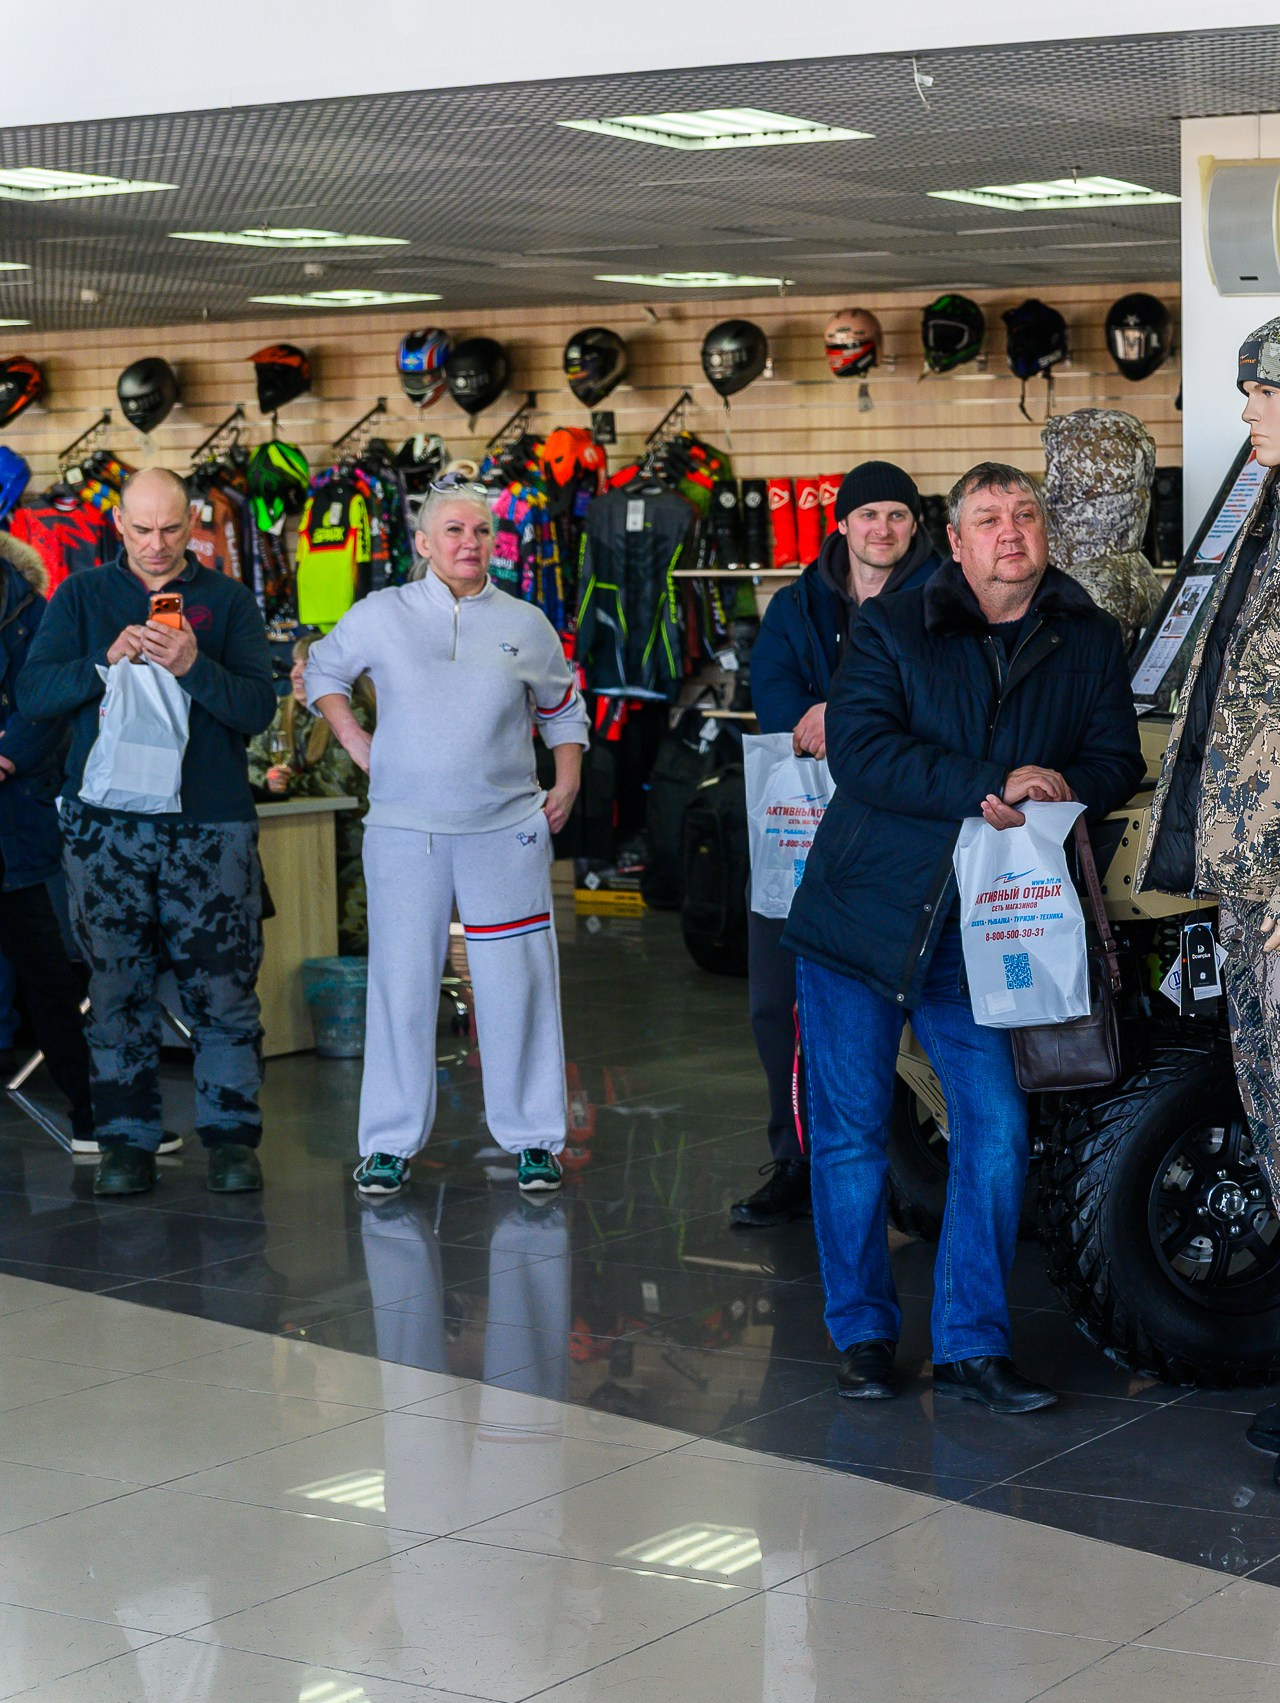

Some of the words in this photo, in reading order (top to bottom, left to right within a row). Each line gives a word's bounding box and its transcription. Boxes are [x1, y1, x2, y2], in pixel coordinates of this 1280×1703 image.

[765, 806, 816, 817] АКТИВНЫЙ
[974, 886, 1020, 906] АКТИВНЫЙ
[1022, 885, 1062, 901] ОТДЫХ
[1005, 902, 1038, 911] МАГАЗИНОВ
[987, 917, 1010, 926] РЫБАЛКА
[1013, 915, 1036, 923] ТУРИЗМ
[985, 927, 1045, 942] 8-800-500-30-31
